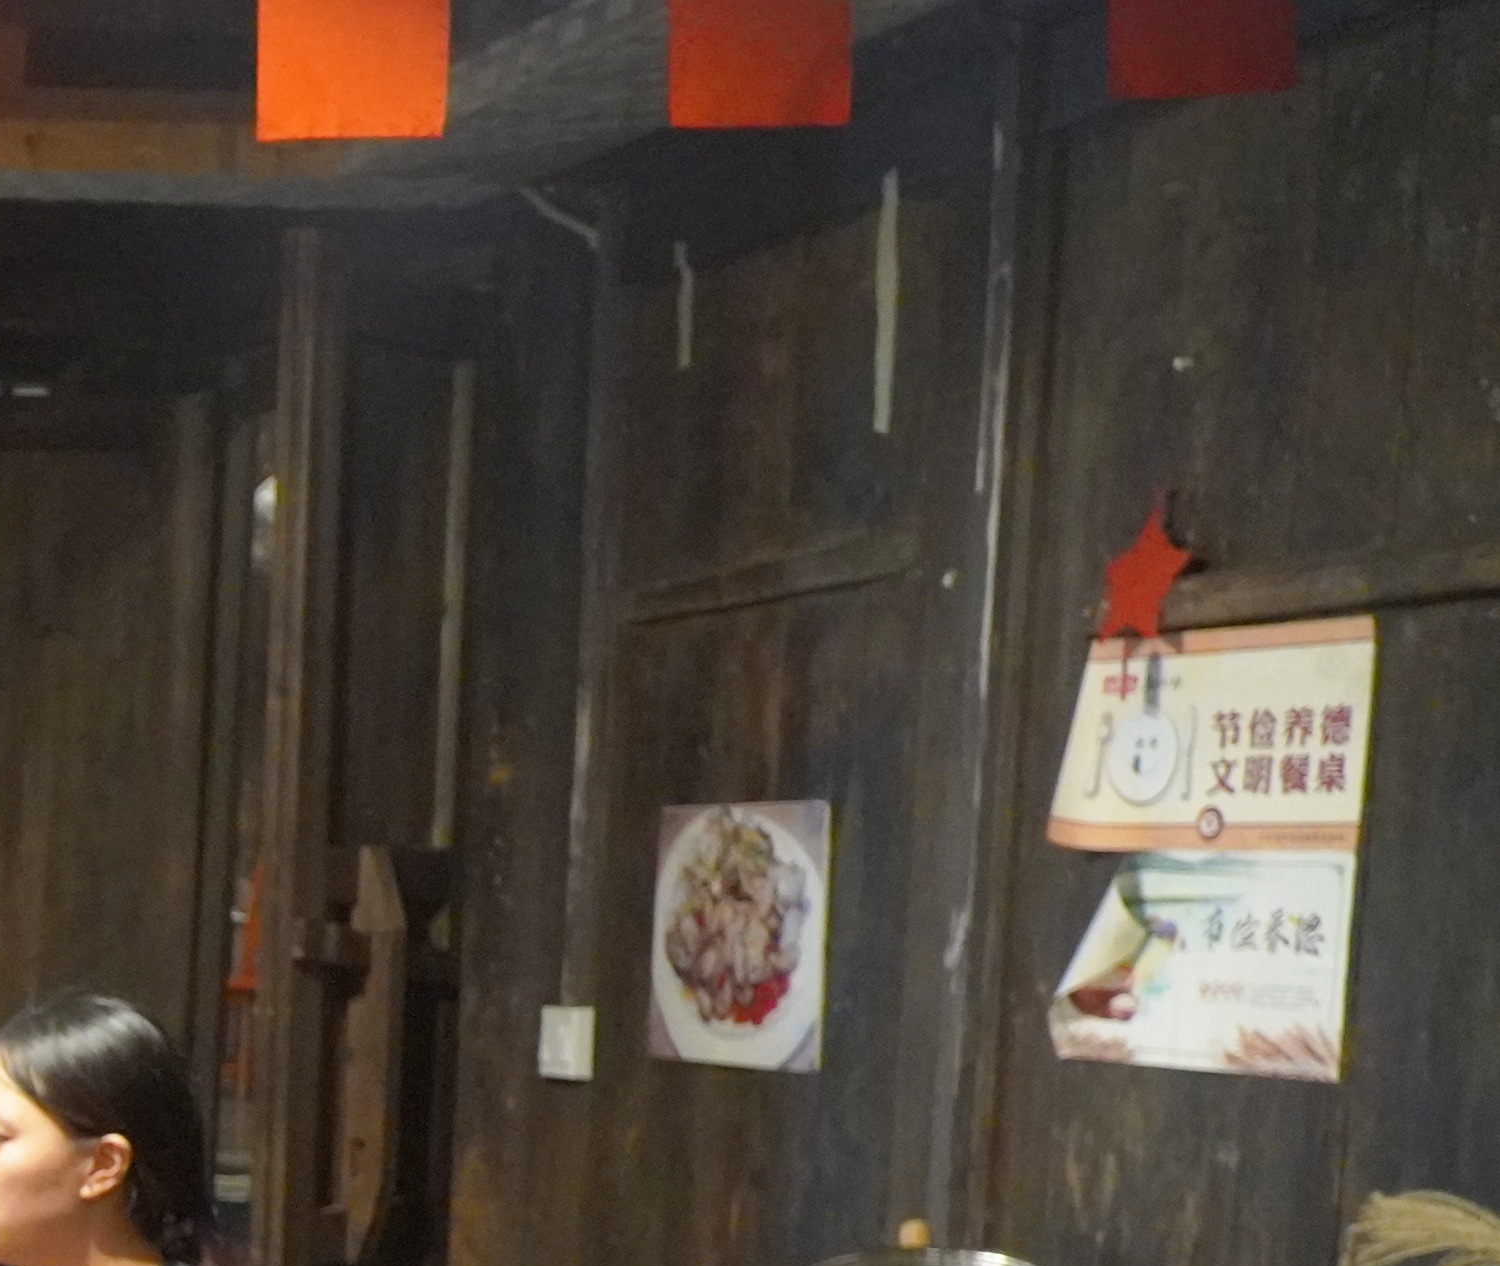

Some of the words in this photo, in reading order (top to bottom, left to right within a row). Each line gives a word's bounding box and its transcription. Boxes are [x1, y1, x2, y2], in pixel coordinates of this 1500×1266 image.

[1213, 704, 1352, 748] 节俭养德
[1207, 753, 1346, 795] 文明餐桌
